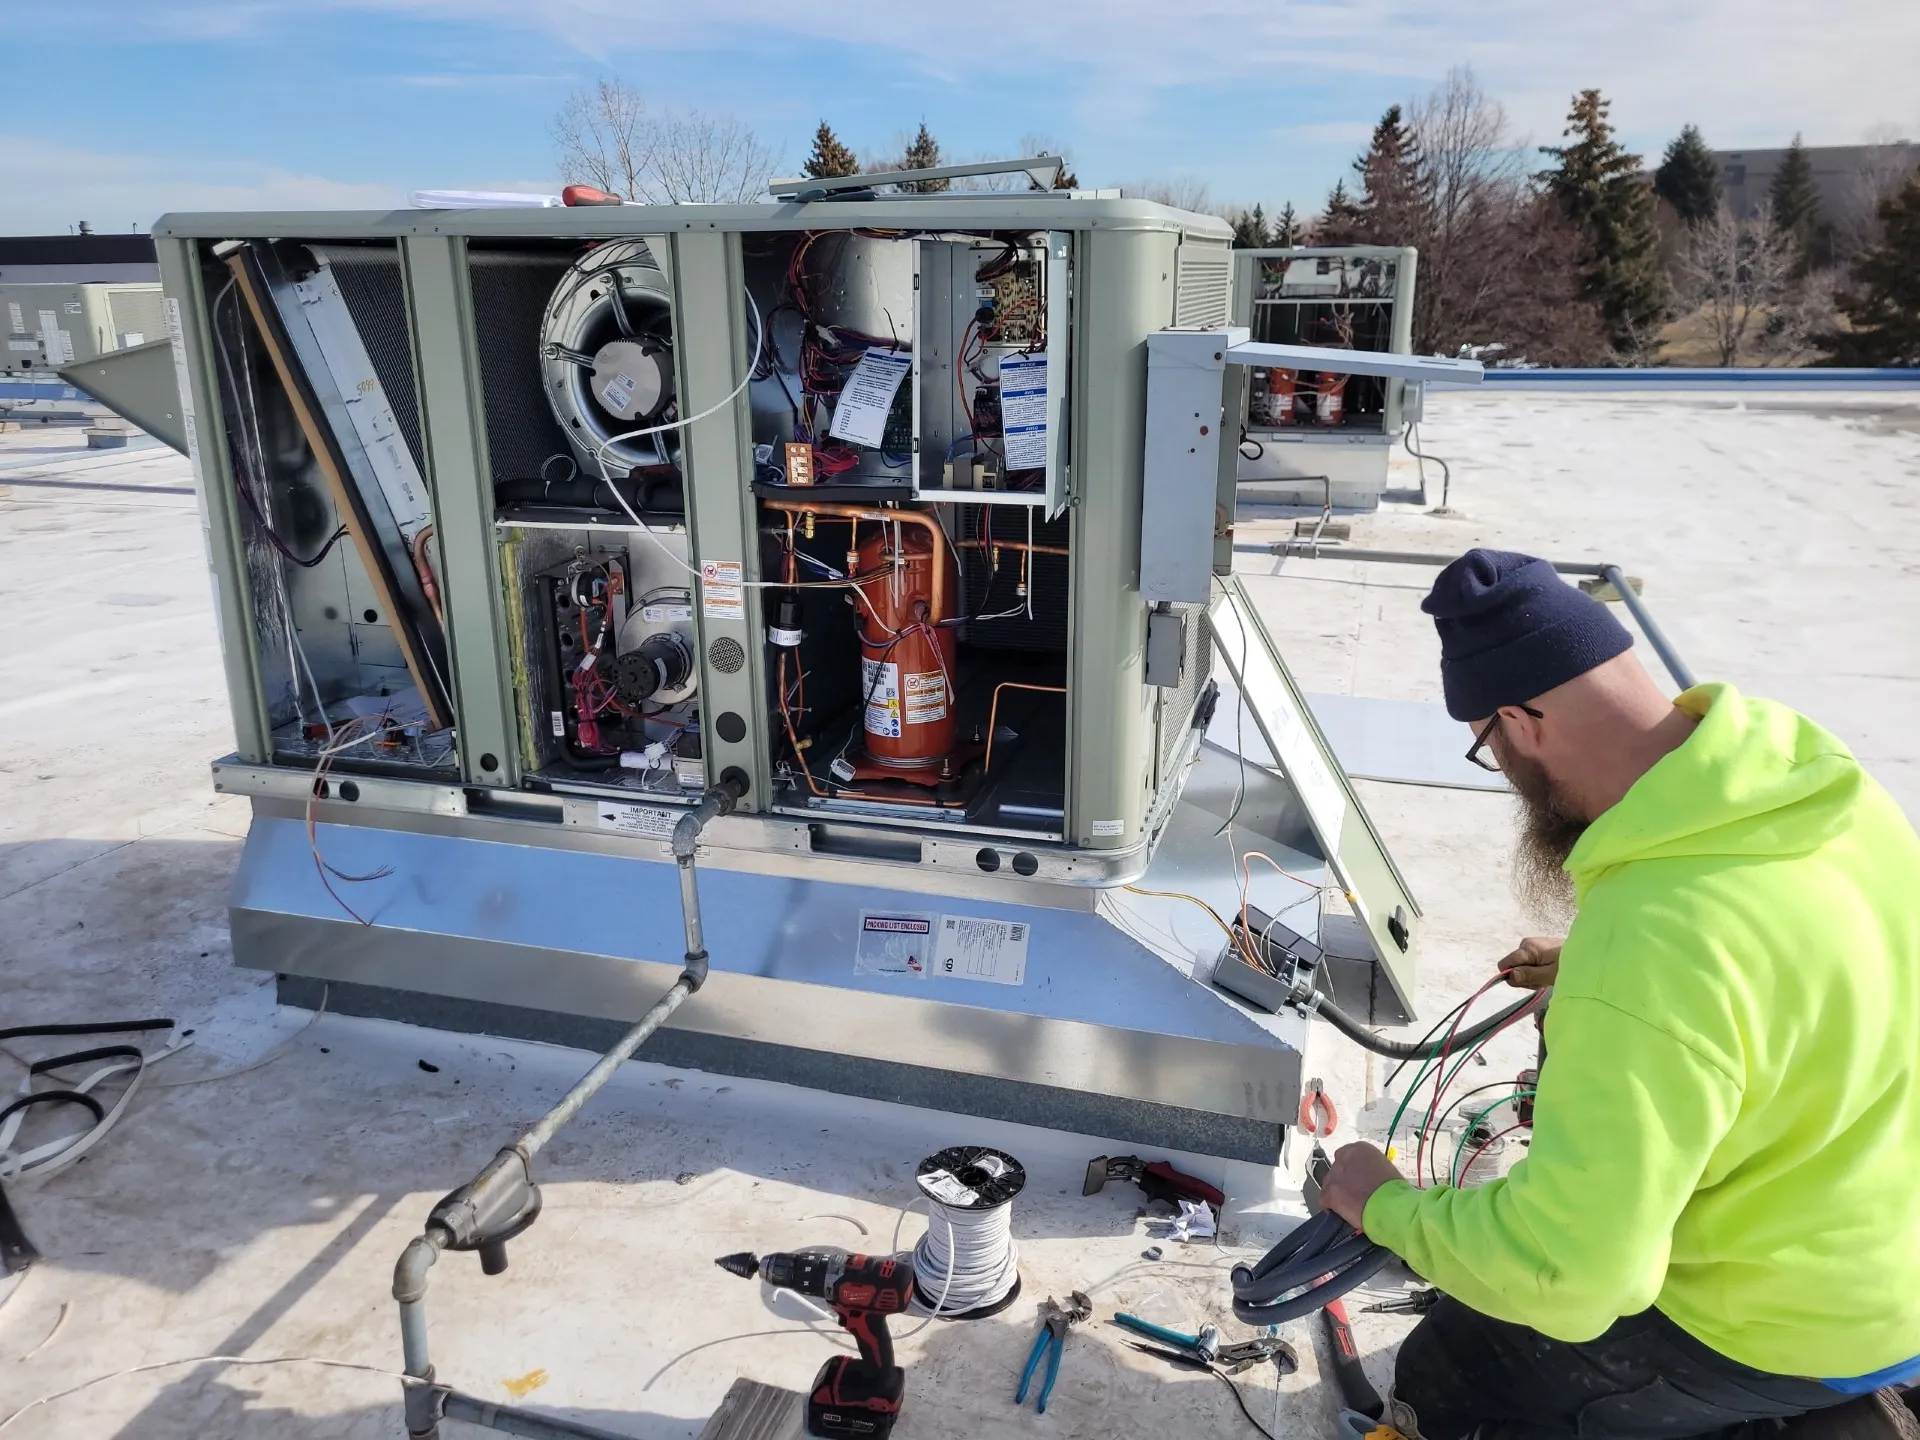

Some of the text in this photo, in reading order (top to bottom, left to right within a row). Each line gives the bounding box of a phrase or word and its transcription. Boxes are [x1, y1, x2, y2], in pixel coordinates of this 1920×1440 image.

[630, 806, 672, 819] IMPORTANT
[867, 920, 888, 929] PACKING
[901, 922, 927, 931] ENCLOSED
